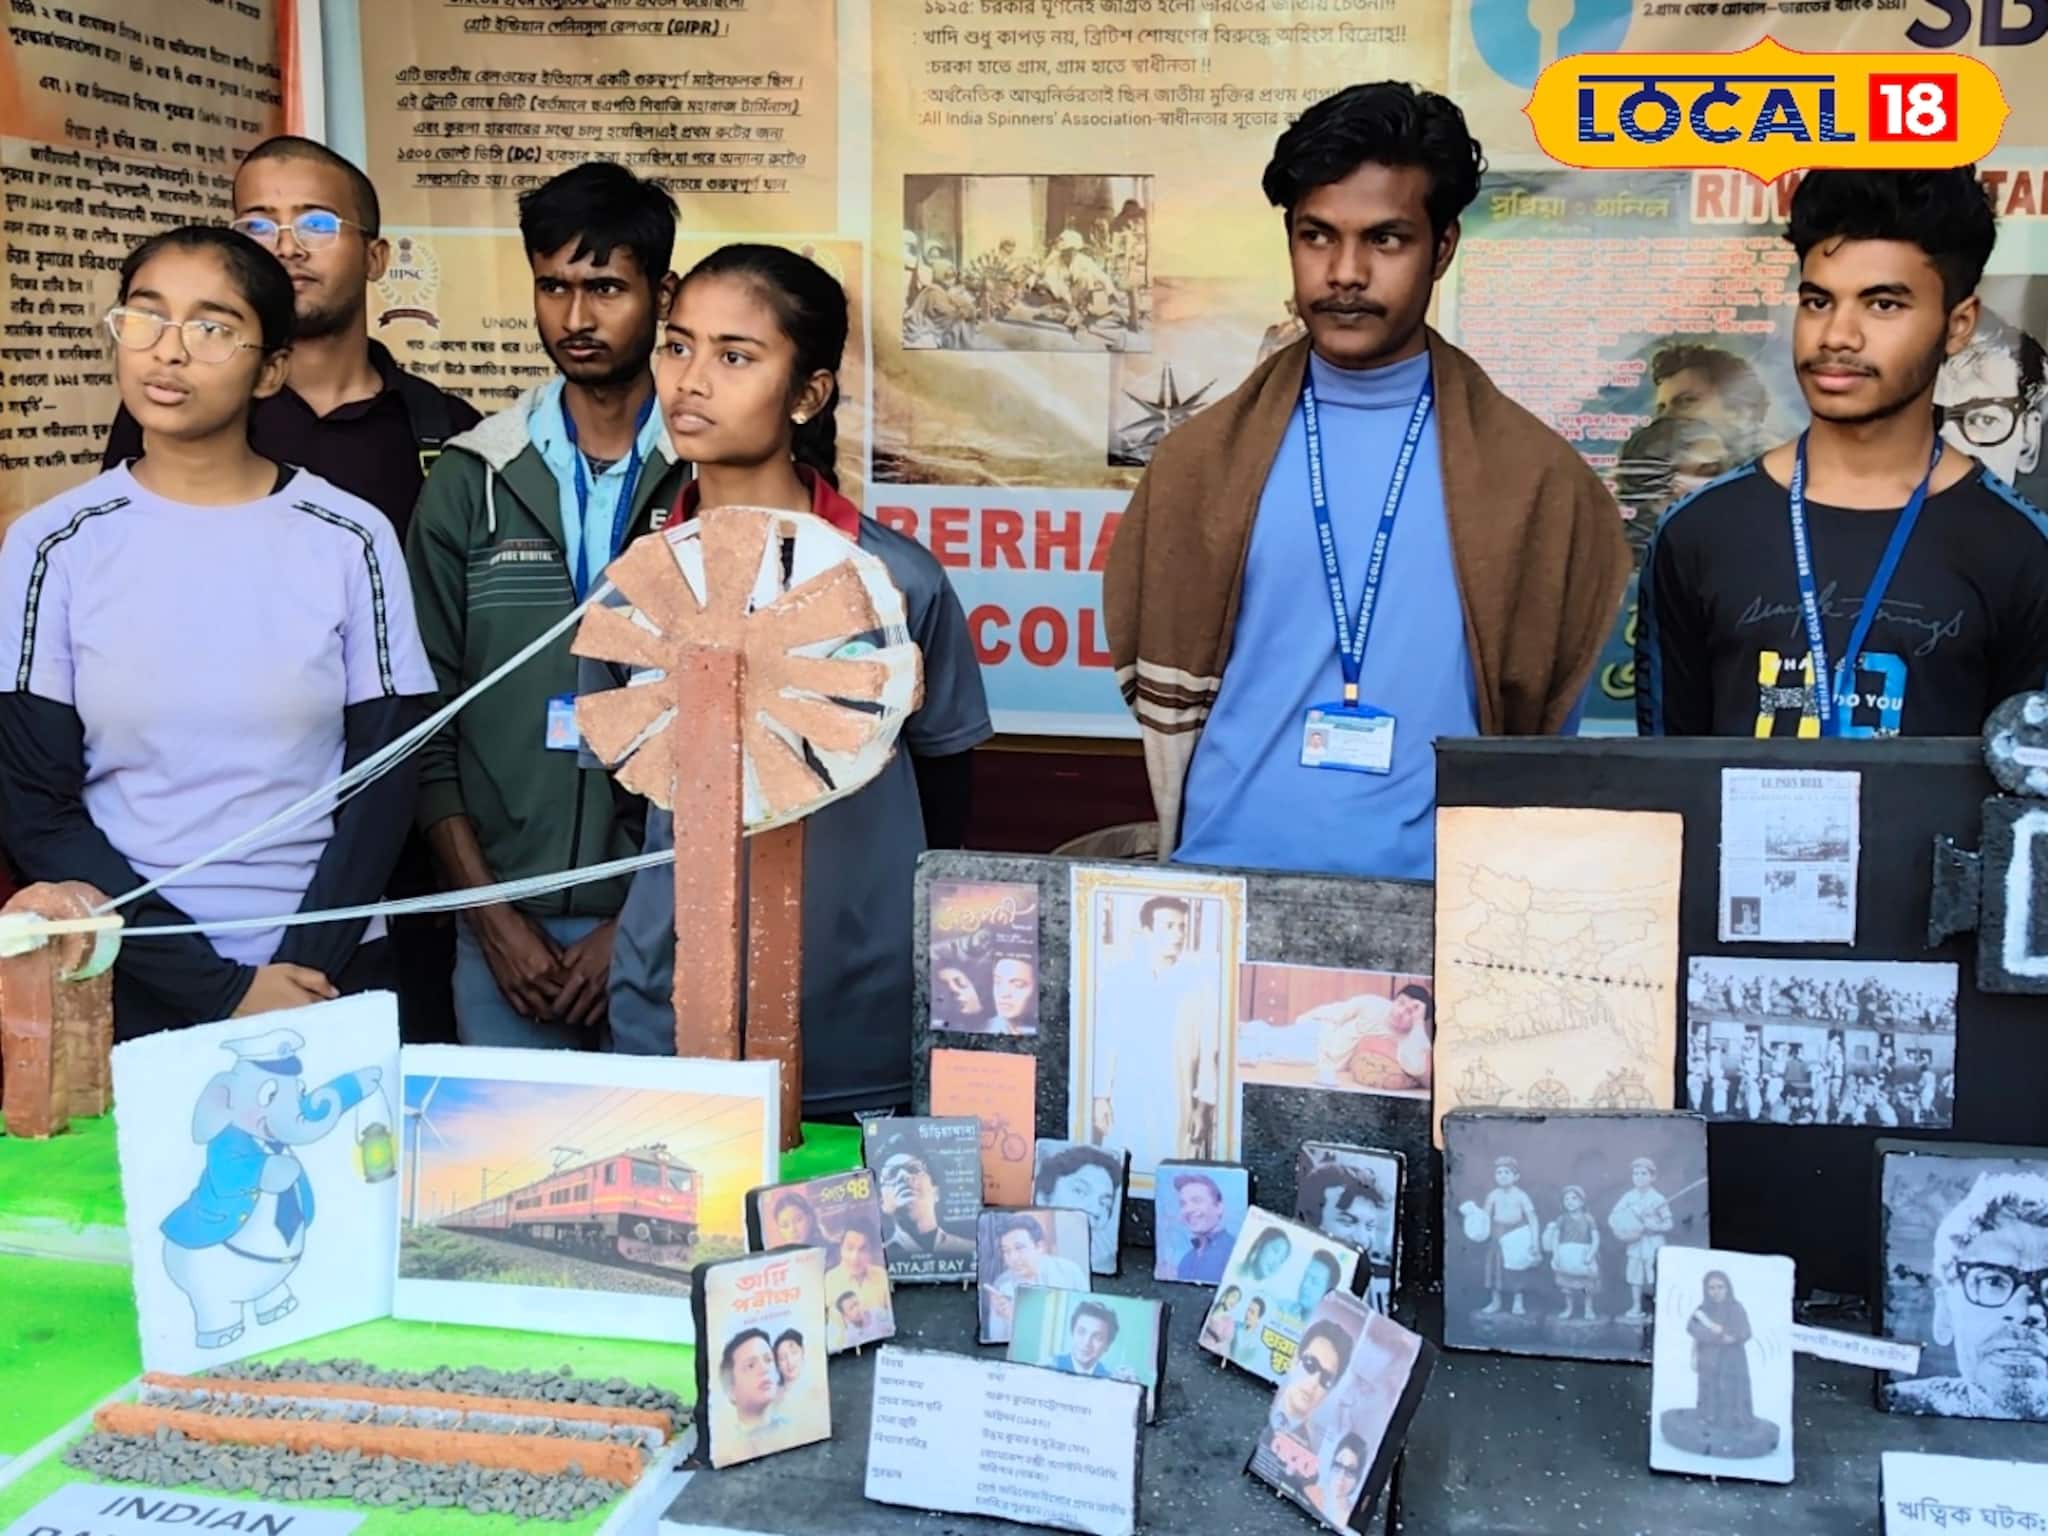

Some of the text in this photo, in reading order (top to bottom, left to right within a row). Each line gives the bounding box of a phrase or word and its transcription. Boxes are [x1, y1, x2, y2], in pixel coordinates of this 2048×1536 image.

[667, 18, 720, 36] (GIPR)
[923, 25, 959, 45] খাদি
[964, 29, 991, 49] শুধু
[996, 30, 1046, 45] কাপড়
[1084, 24, 1133, 46] ব্রিটিশ
[1138, 28, 1208, 44] শোষণের
[1214, 24, 1271, 46] বিরুদ্ধে
[978, 60, 1012, 74] হাতে
[1016, 60, 1051, 75] গ্রাম,
[1055, 60, 1086, 74] গ্রাম
[1091, 59, 1126, 74] হাতে
[1131, 53, 1197, 74] স্বাধীনতা
[395, 66, 794, 89] এটি ভারতীয় রেলওয়ের ইতিহাসে একটি গুরুত্বপূর্ণ মাইলফলক ছিল
[397, 94, 417, 107] এই
[421, 92, 458, 110] ট্রেনটি
[499, 92, 526, 110] ভিটি
[687, 99, 737, 113] মহারাজ
[1118, 86, 1148, 102] ছিল
[1154, 84, 1205, 102] জাতীয়
[1210, 84, 1255, 107] মুক্তির
[1259, 88, 1297, 102] প্রথম
[946, 112, 983, 126] India
[413, 122, 440, 136] এবং
[579, 126, 603, 141] চালু
[681, 125, 711, 138] প্রথম
[755, 126, 785, 142] জন্য
[507, 144, 542, 163] (DC)
[691, 152, 716, 165] পরে
[1981, 171, 2048, 215] TA
[481, 316, 529, 330] UNION
[1303, 386, 1325, 507] BERHAMPORE COLLEGE
[1384, 394, 1431, 518] BERHAMPORE COLLEGE
[1791, 502, 1810, 577] BERHAMPORE
[1368, 531, 1388, 583] COLLEGE
[1319, 522, 1352, 654] BERHAMPORE COLLEGE
[1802, 590, 1831, 721] BERHAMPORE COLLEGE
[1865, 693, 1903, 711] YOU
[938, 1258, 964, 1272] RAY
[97, 1495, 297, 1536] INDIAN
[1897, 1496, 1973, 1529] ঋত্বিক
